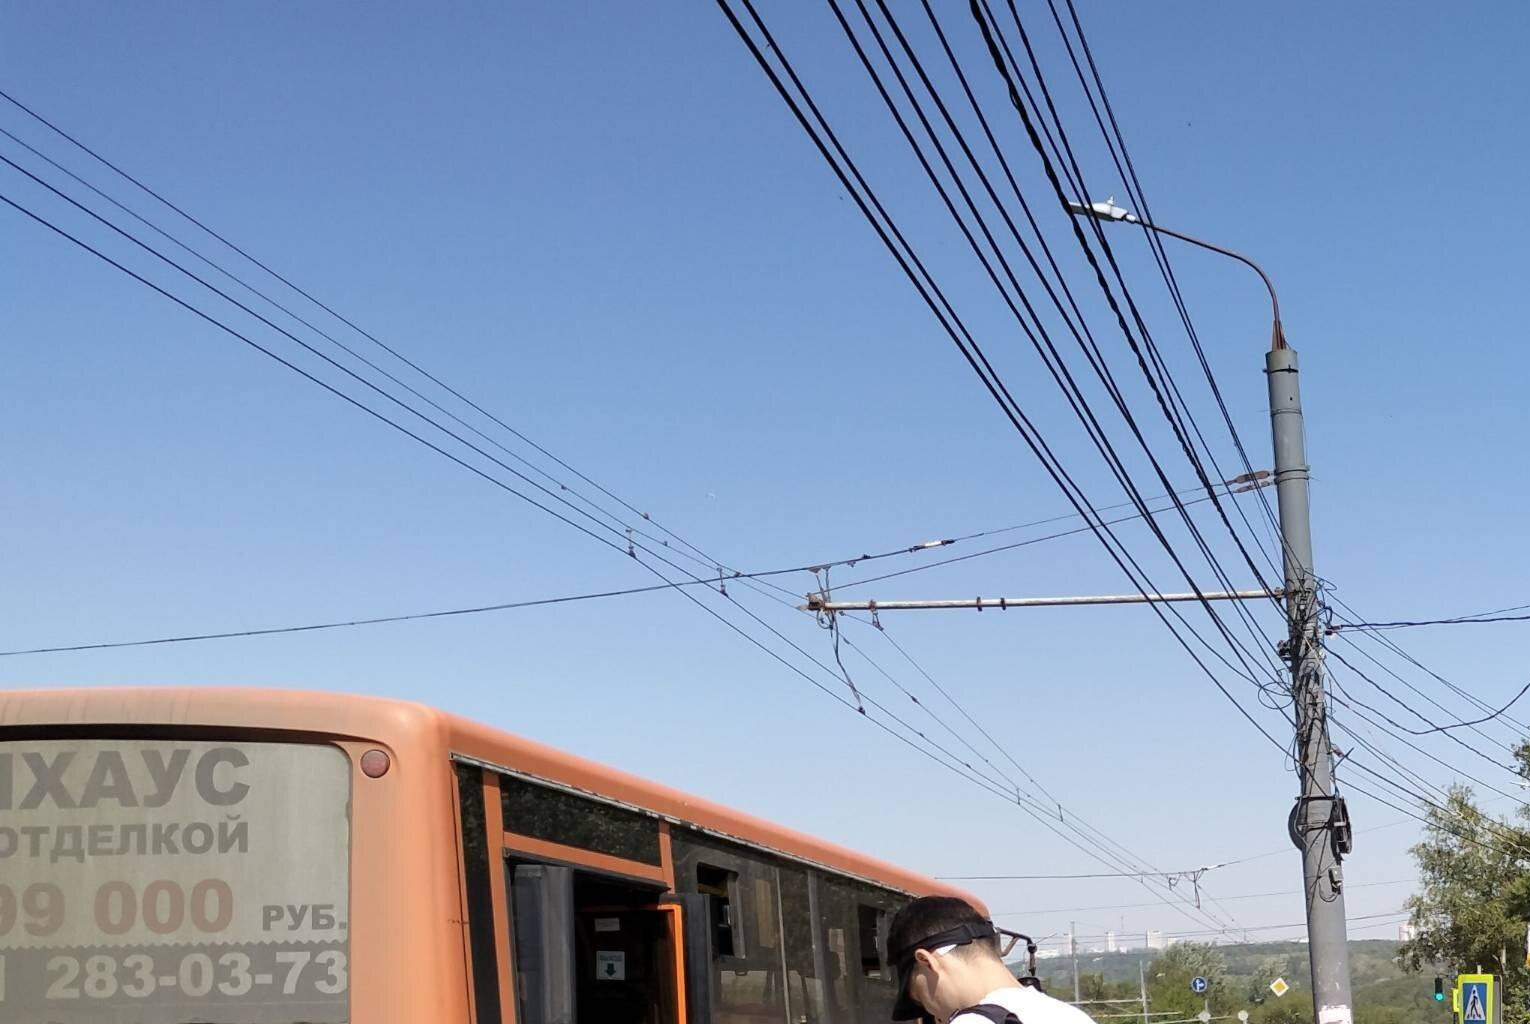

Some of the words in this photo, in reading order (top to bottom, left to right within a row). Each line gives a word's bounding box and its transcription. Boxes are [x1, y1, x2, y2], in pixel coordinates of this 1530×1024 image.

[0, 747, 250, 810] ХАУС
[94, 878, 233, 935] 000
[262, 905, 346, 931] РУБ.
[45, 951, 347, 999] 283-03-73
